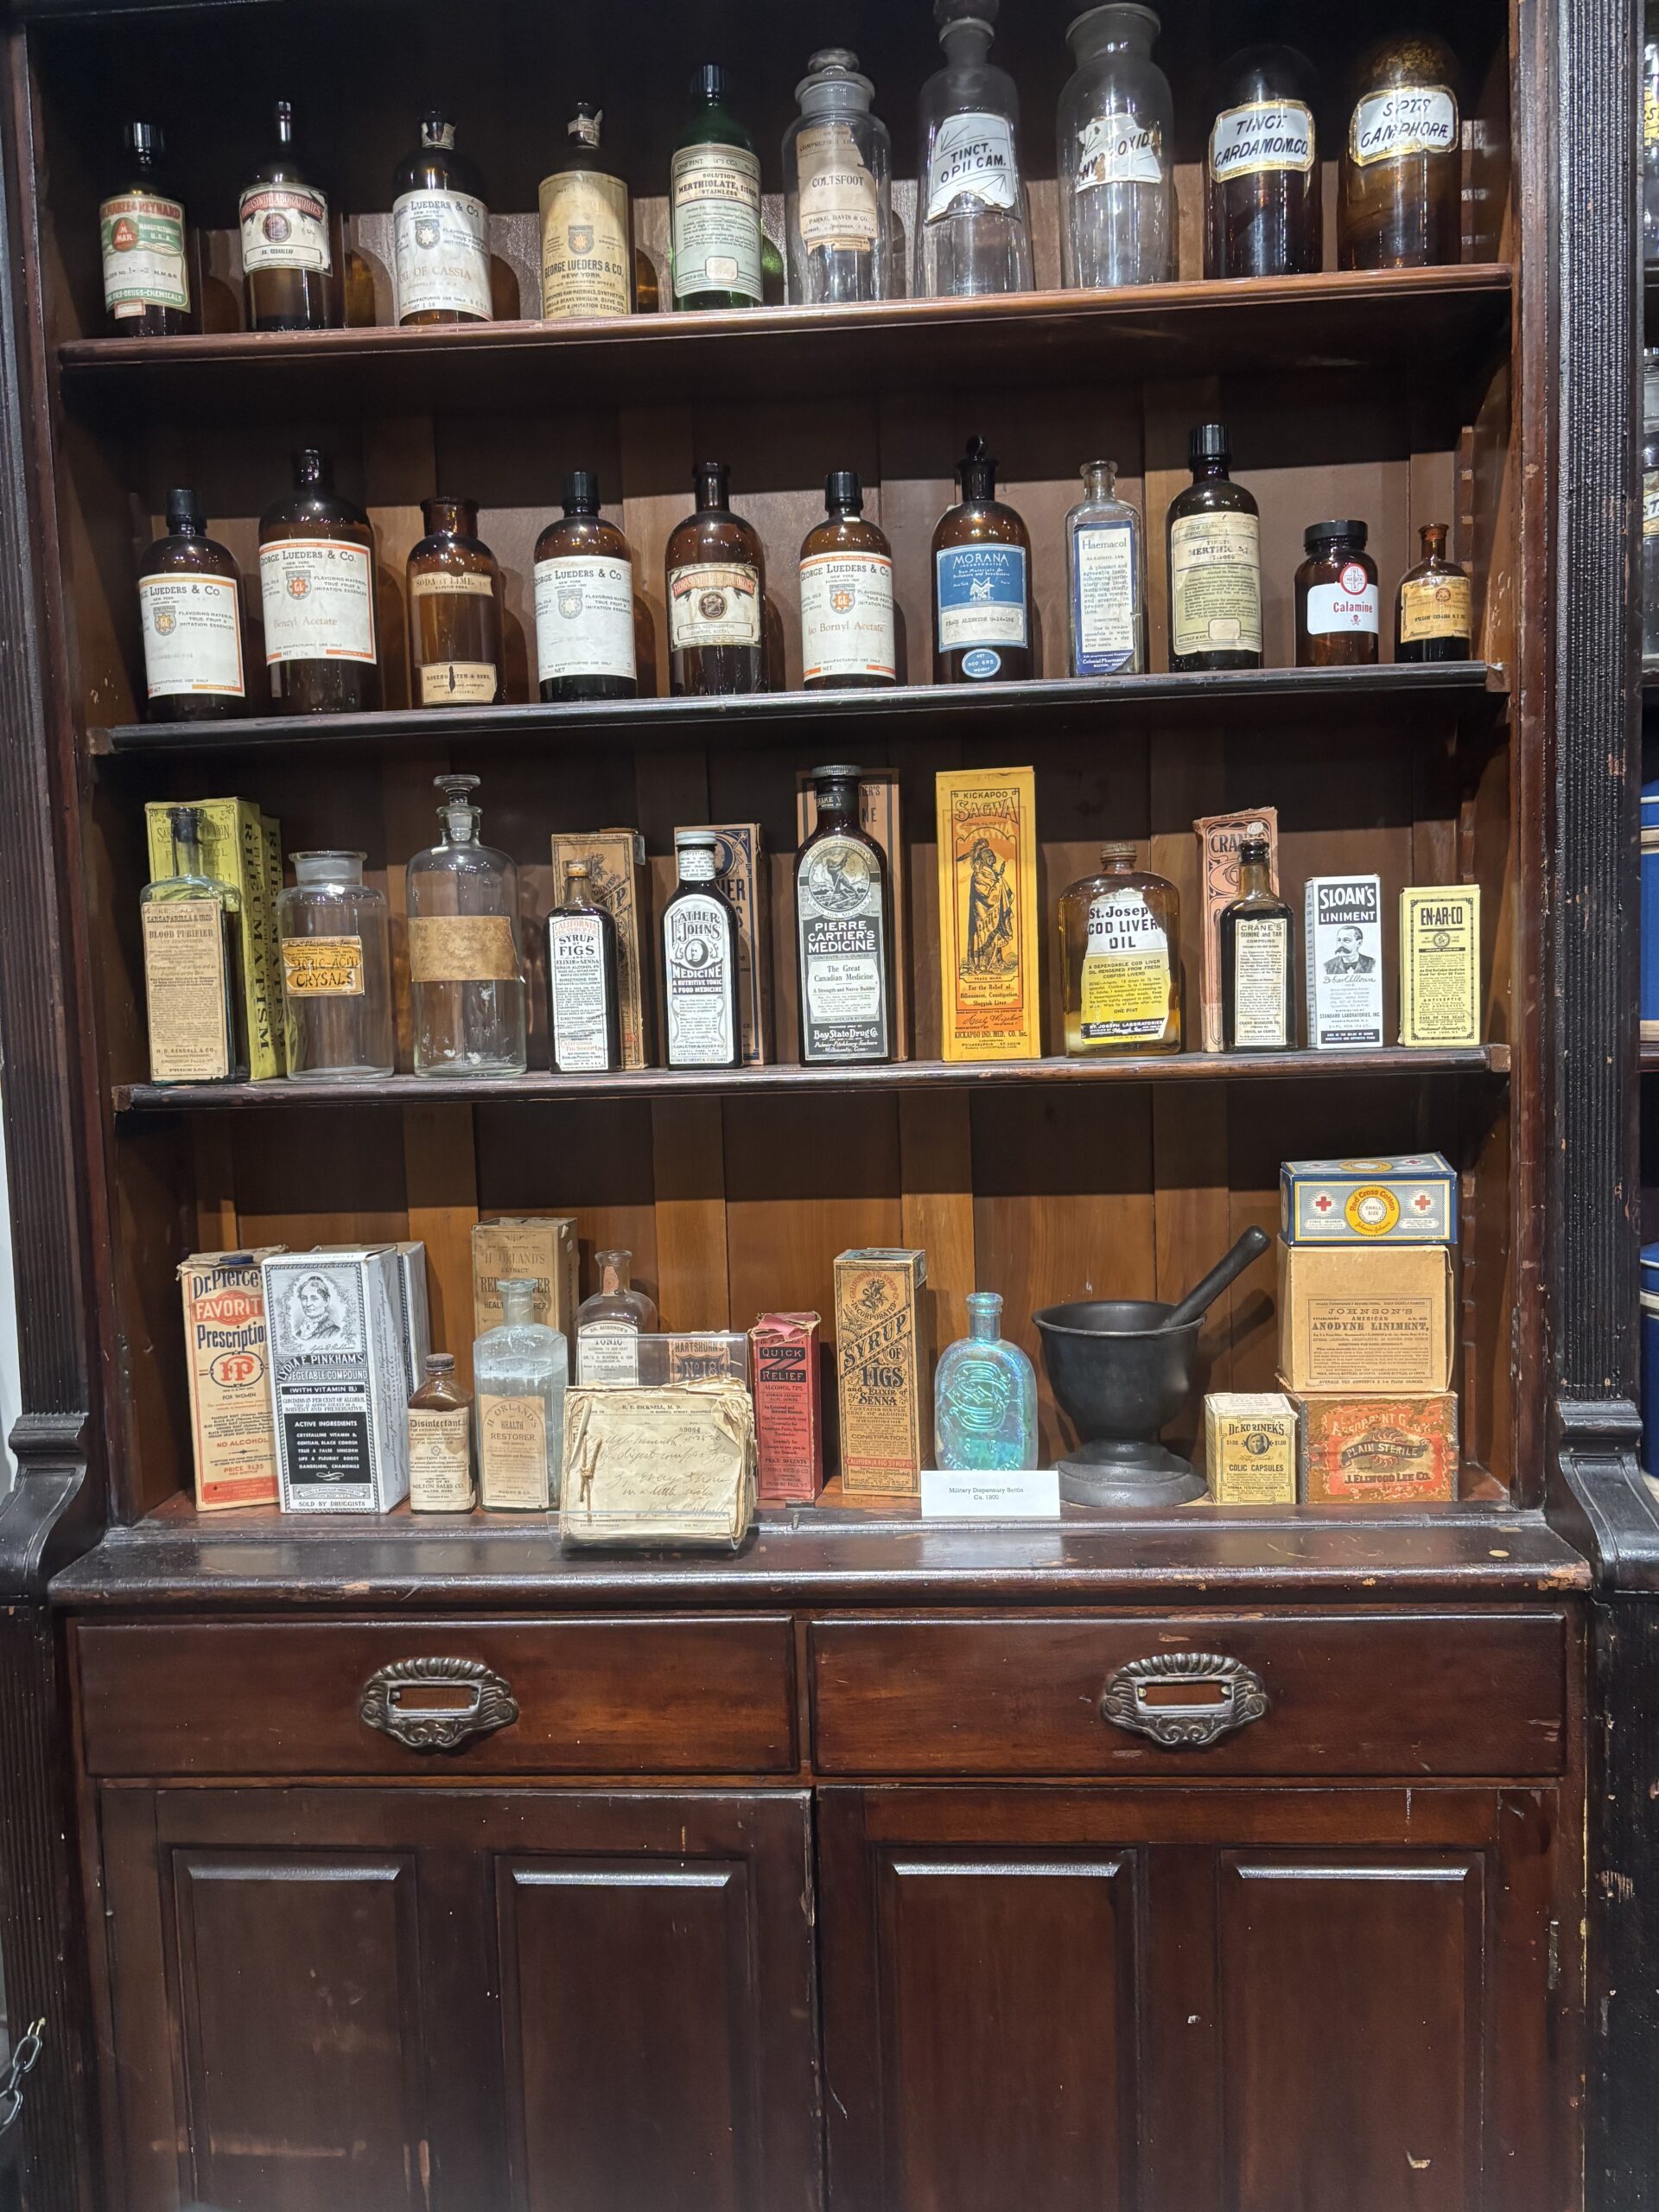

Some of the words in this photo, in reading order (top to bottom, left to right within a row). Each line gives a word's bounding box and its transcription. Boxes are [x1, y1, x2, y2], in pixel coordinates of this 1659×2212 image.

[1236, 115, 1284, 136] TINCT.
[950, 143, 992, 162] TINCT.
[941, 162, 969, 183] OPII
[976, 155, 1007, 168] CAM.
[812, 176, 865, 188] COLTSFOOT
[411, 200, 451, 210] LUEDERS
[455, 200, 463, 212] &
[832, 214, 851, 223] DAVIS
[414, 268, 427, 277] OF
[434, 266, 472, 282] CASSIA
[545, 261, 566, 278] GEORGE
[568, 259, 603, 271] LUEDERS
[605, 261, 610, 272] &
[1082, 537, 1127, 550] Haemacol
[282, 550, 323, 560] LUEDERS
[327, 550, 335, 559] &
[953, 553, 1009, 569] MORANA
[556, 569, 594, 580] LUEDERS
[599, 568, 606, 577] &
[826, 564, 867, 574] LUEDERS
[871, 564, 877, 573] &
[416, 578, 435, 587] SODA
[149, 586, 188, 596] LUEDERS
[192, 585, 200, 594] &
[1332, 601, 1373, 614] Calamine
[302, 616, 338, 626] Acetate
[820, 622, 849, 633] Bornyl
[855, 621, 885, 632] Acetate
[963, 791, 1007, 799] KICKAPOO
[954, 796, 1019, 824] SAGWA
[1319, 887, 1376, 909] SLOAN'S
[1106, 906, 1150, 918] Josep
[1320, 911, 1376, 923] LINIMENT
[815, 920, 867, 932] PIERRE
[1089, 922, 1113, 935] COD
[1119, 918, 1158, 932] LIVER
[149, 930, 175, 939] BLOOD
[177, 929, 214, 938] PURIFIER
[558, 934, 594, 944] SYRUP
[807, 930, 875, 943] CARTIER'S
[808, 940, 876, 953] MEDICINE
[1109, 936, 1136, 949] OIL
[559, 945, 594, 957] FIGS
[672, 963, 722, 979] MEDICINE
[814, 1029, 830, 1040] Bay
[830, 1029, 849, 1039] State
[849, 1028, 870, 1038] Drug
[1350, 1197, 1359, 1211] Red
[1358, 1189, 1379, 1198] Cross
[1379, 1190, 1395, 1211] Cotton
[193, 1275, 212, 1300] Dr.
[196, 1297, 263, 1319] FAVORIT
[1312, 1322, 1364, 1331] ANODYNE
[844, 1313, 908, 1370] SYRUP
[762, 1348, 802, 1357] QUICK
[888, 1348, 902, 1360] OF
[277, 1356, 300, 1382] LYDIA
[311, 1354, 365, 1364] PINKHAM'S
[327, 1370, 367, 1380] COMPOUND
[861, 1363, 904, 1388] FIGS
[858, 1392, 898, 1406] SENNA
[501, 1421, 524, 1430] HEALTH
[1229, 1424, 1240, 1436] Dr.
[1240, 1421, 1285, 1436] KORINEK'S
[230, 1438, 270, 1446] ALCOHOL
[1346, 1444, 1375, 1458] PLAIN
[1377, 1444, 1419, 1456] STERILE
[1396, 1473, 1414, 1482] LEE
